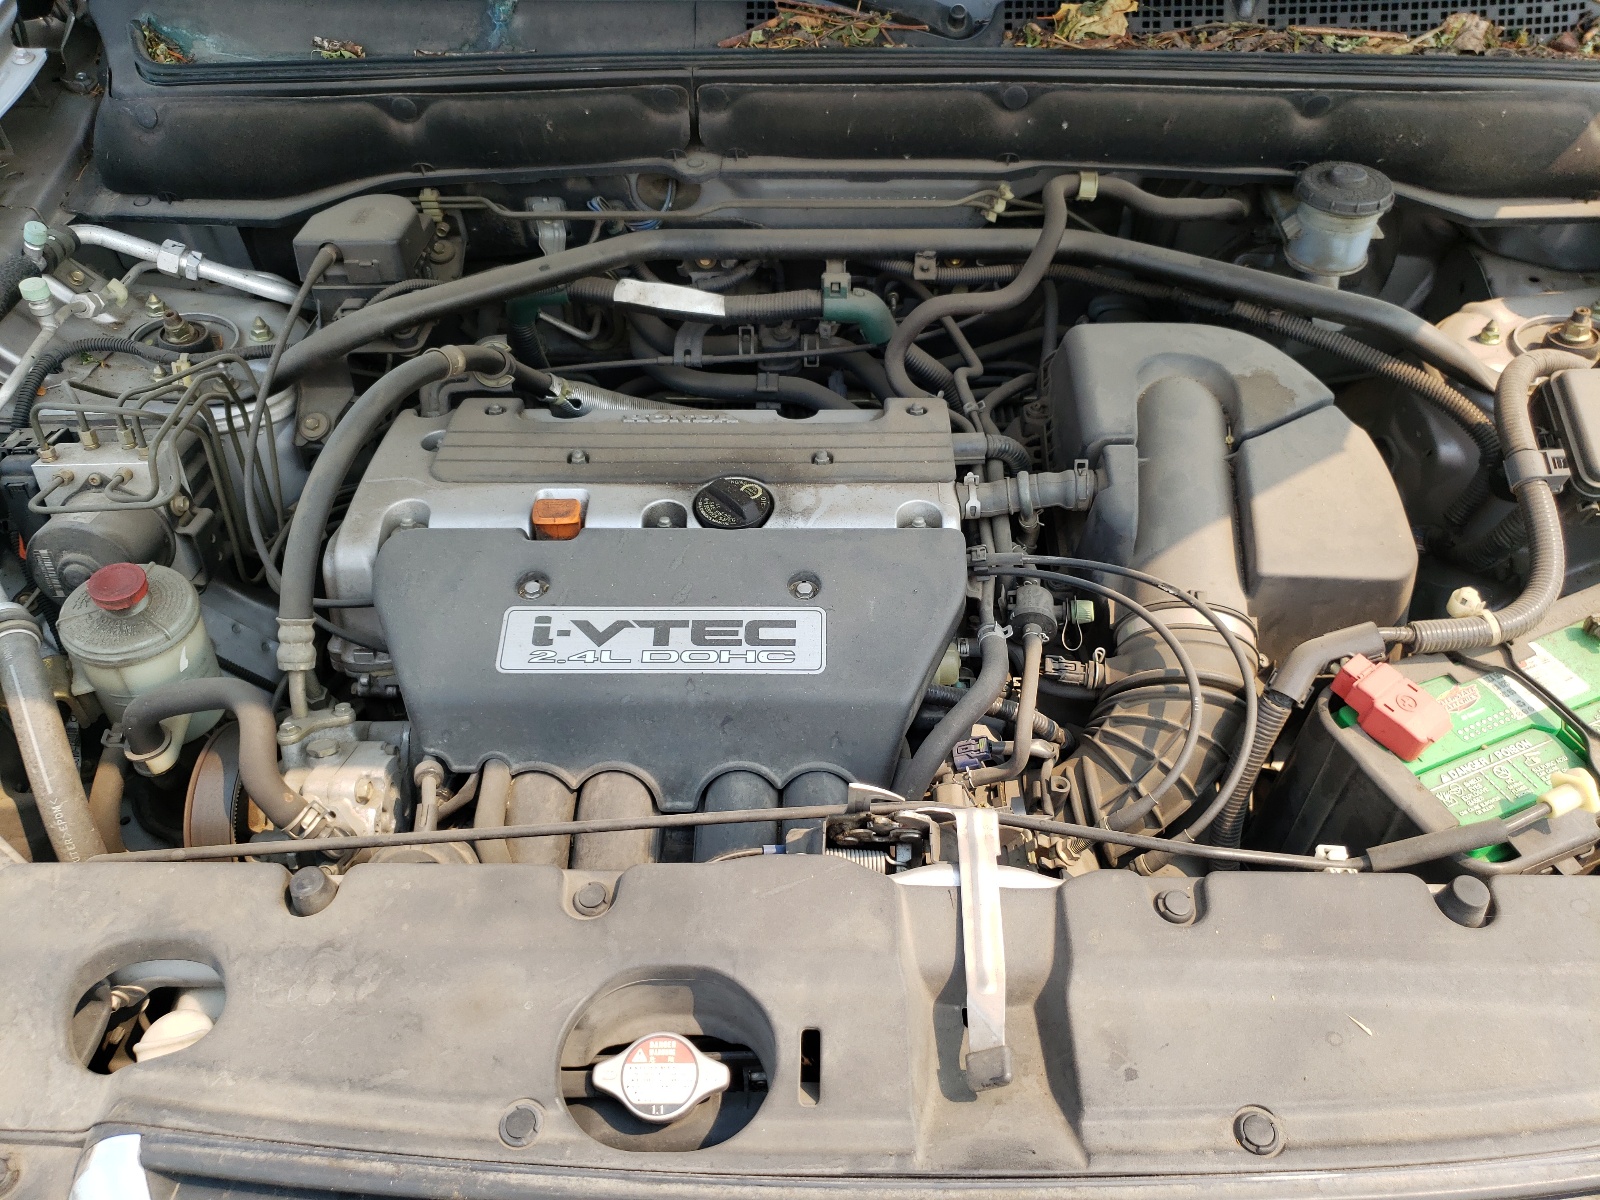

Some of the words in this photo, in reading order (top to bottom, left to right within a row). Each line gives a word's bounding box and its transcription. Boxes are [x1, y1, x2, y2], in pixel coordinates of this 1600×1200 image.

[622, 413, 740, 424] HONDA
[532, 615, 797, 648] i-VTEC
[528, 650, 632, 664] 2.4L
[641, 650, 796, 664] DOHC
[1447, 756, 1490, 780] DANGER
[1493, 738, 1533, 760] POISON
[651, 1104, 664, 1115] 1.1
